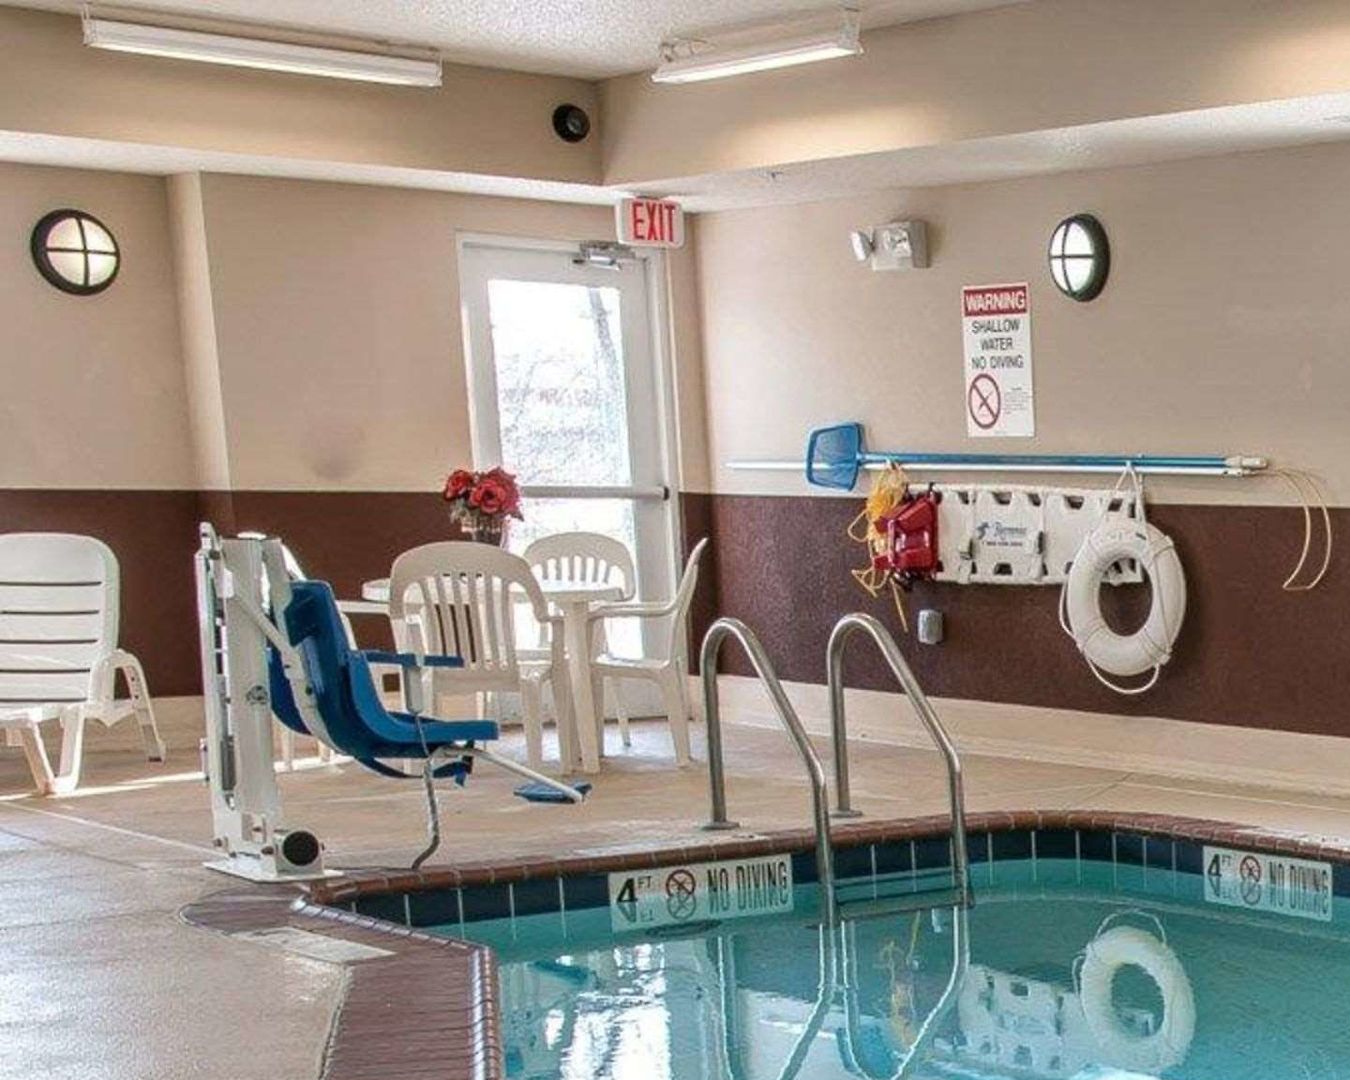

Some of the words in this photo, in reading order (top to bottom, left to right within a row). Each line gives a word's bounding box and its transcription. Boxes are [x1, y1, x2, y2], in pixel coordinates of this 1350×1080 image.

[632, 202, 676, 242] EXIT
[965, 290, 1025, 311] WARNING
[971, 319, 1020, 334] SHALLOW
[981, 337, 1014, 351] WATER
[971, 355, 987, 369] NO
[990, 354, 1024, 369] DIVING
[1208, 854, 1222, 876] 4
[1269, 862, 1285, 885] NO
[616, 878, 638, 902] 4
[638, 876, 652, 888] FT
[707, 868, 729, 892] NO
[735, 862, 788, 891] DIVING
